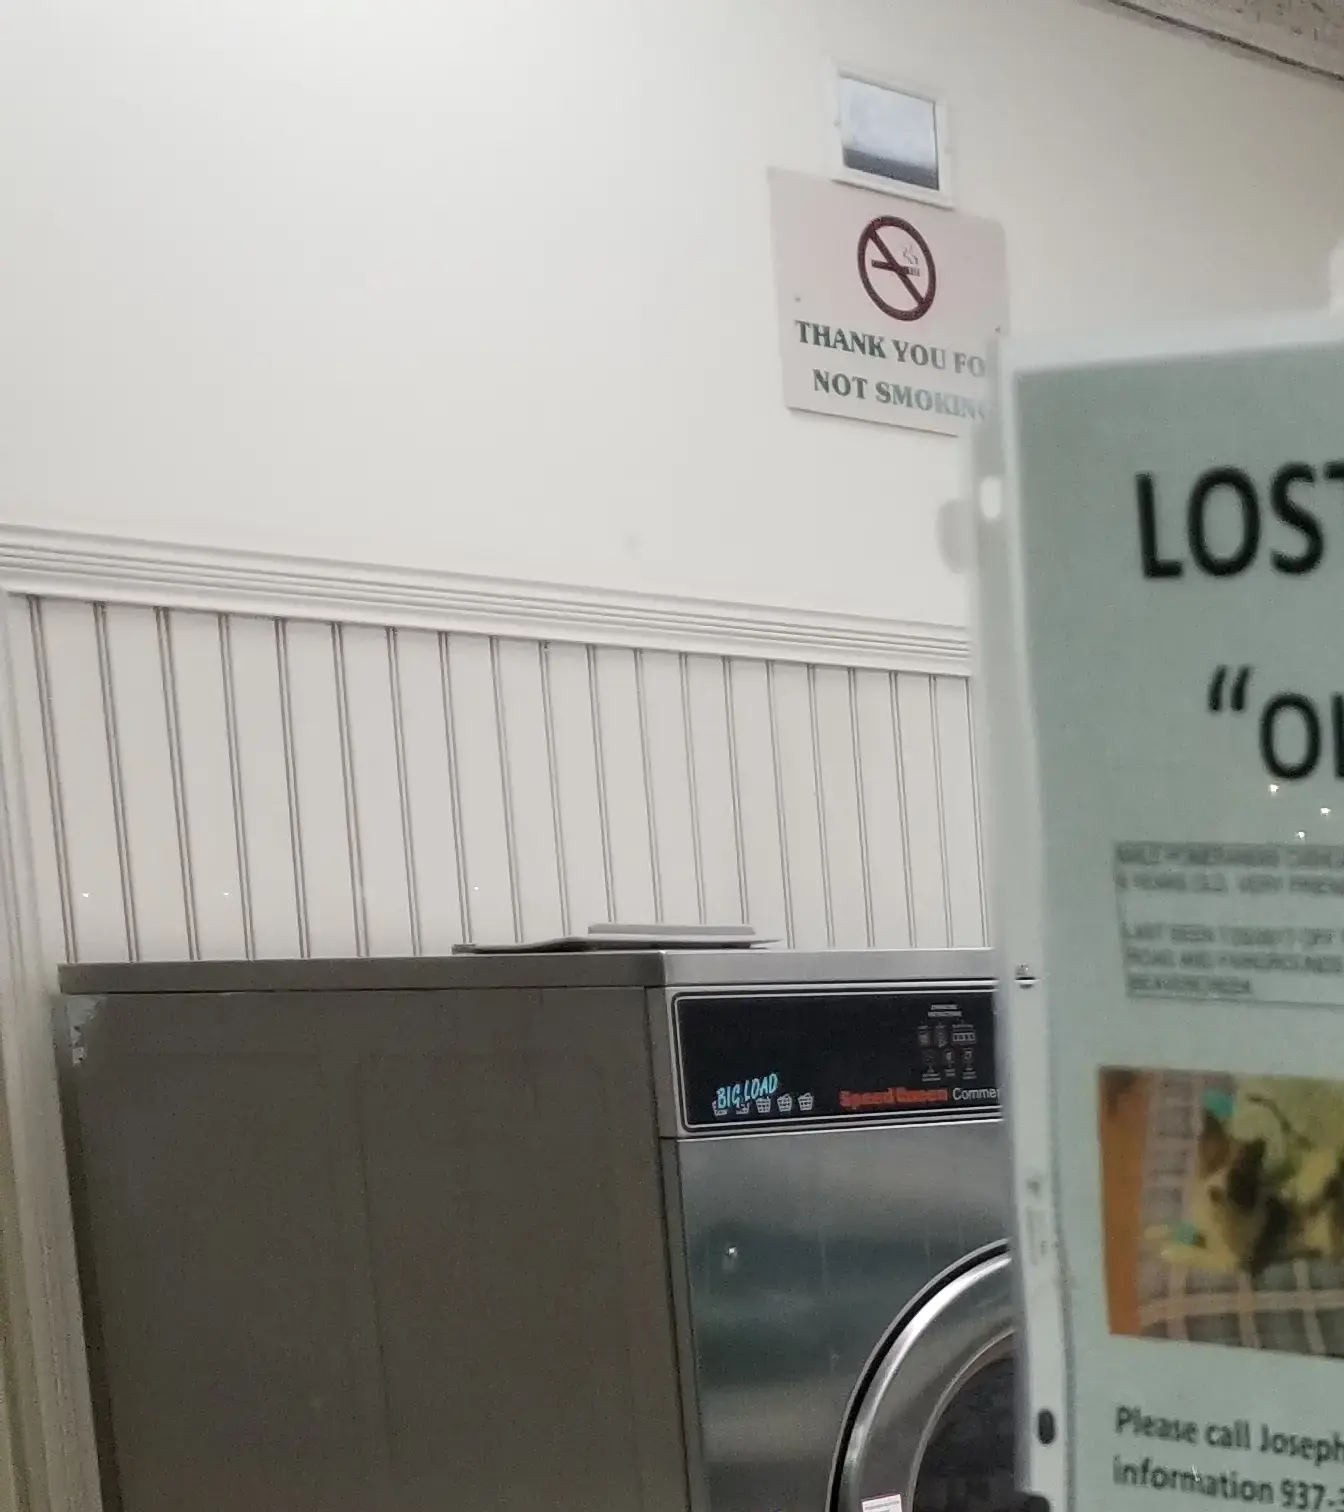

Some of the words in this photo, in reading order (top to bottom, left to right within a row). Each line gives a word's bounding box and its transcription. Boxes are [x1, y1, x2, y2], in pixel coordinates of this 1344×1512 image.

[795, 320, 885, 358] THANK
[892, 339, 945, 370] YOU
[954, 351, 986, 378] FO
[812, 368, 868, 399] NOT
[875, 381, 987, 420] SMOKIN
[716, 1084, 741, 1109] BIG
[744, 1072, 779, 1101] LOAD
[1114, 1404, 1199, 1444] Please
[1204, 1418, 1252, 1451] call
[1112, 1453, 1275, 1504] information
